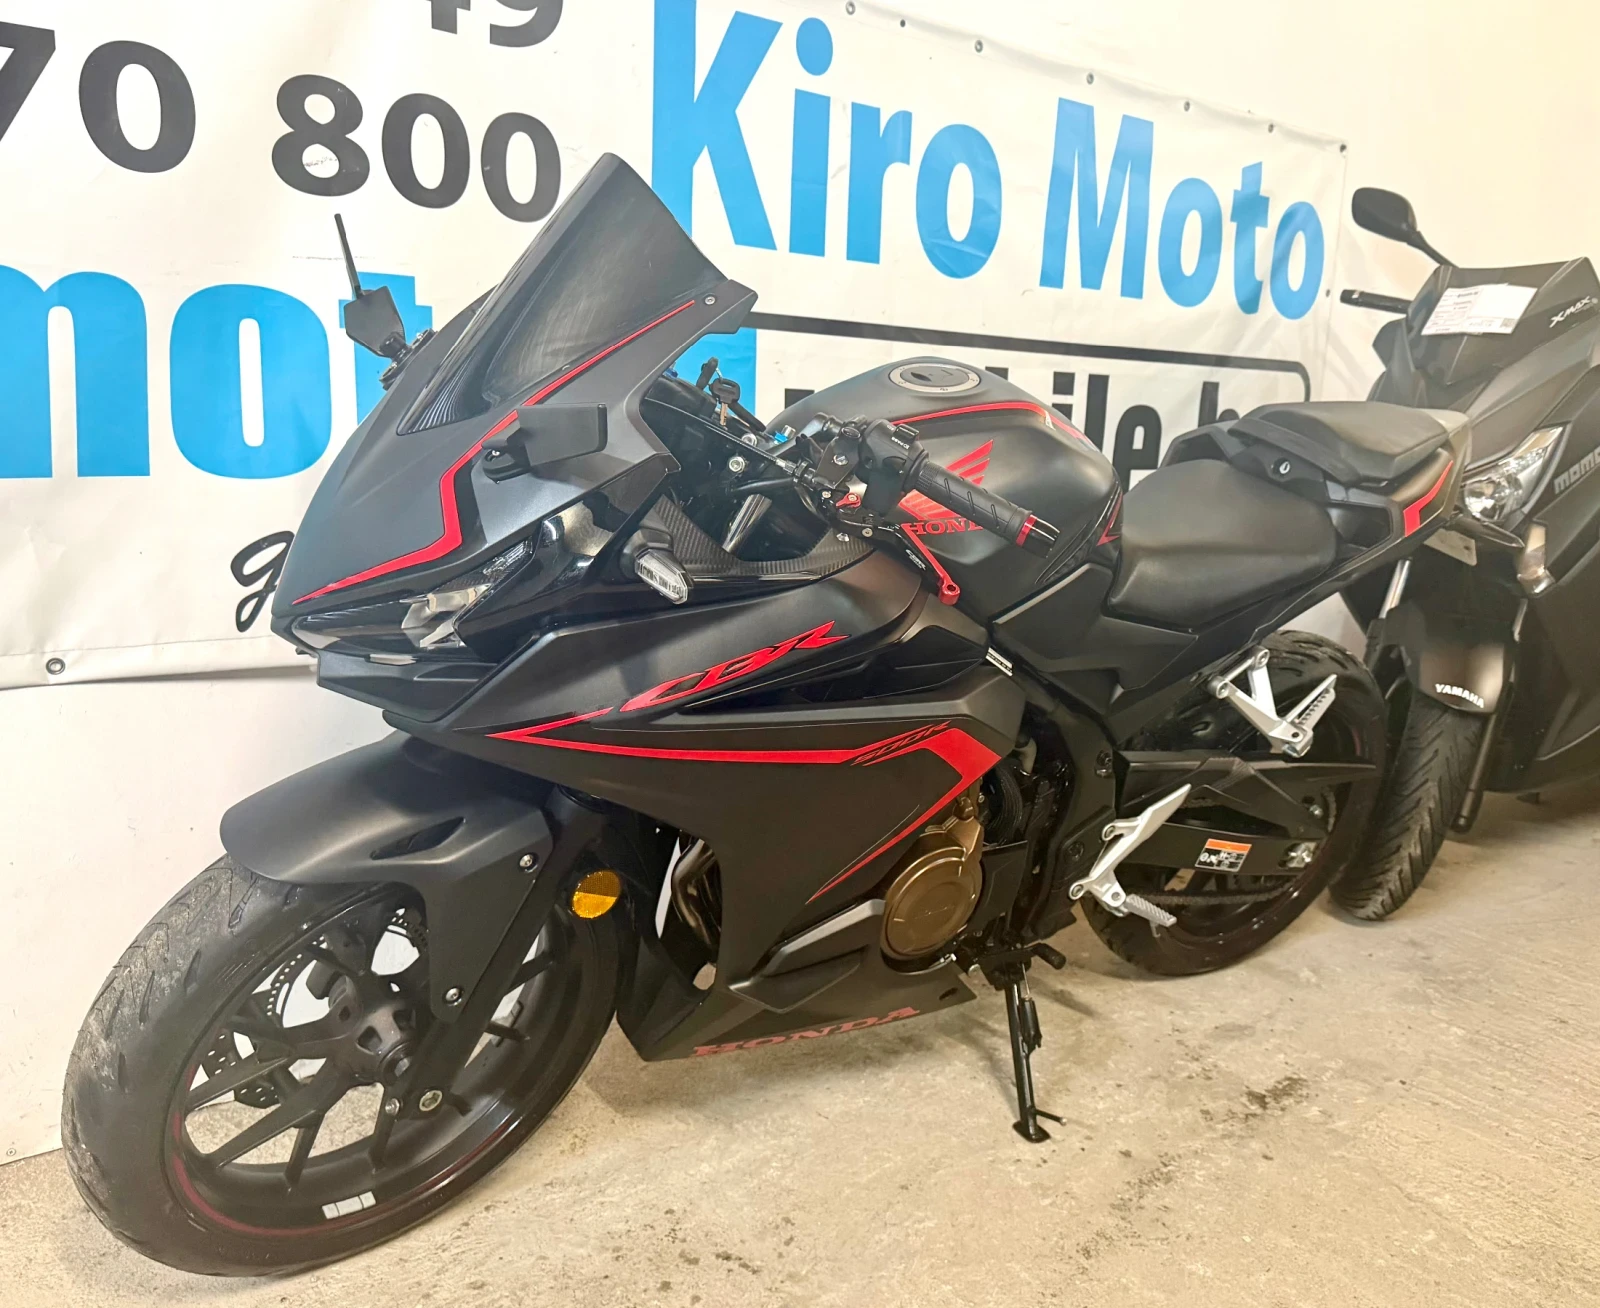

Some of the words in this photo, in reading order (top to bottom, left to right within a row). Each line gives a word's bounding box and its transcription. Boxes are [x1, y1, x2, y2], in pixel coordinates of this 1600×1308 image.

[271, 75, 561, 223] 800
[651, 0, 1003, 279] Kiro
[1039, 97, 1324, 320] Moto
[620, 620, 849, 712] CBR
[1435, 683, 1485, 709] YAMAHA
[850, 719, 952, 767] 500R
[693, 1006, 920, 1057] HONDA
